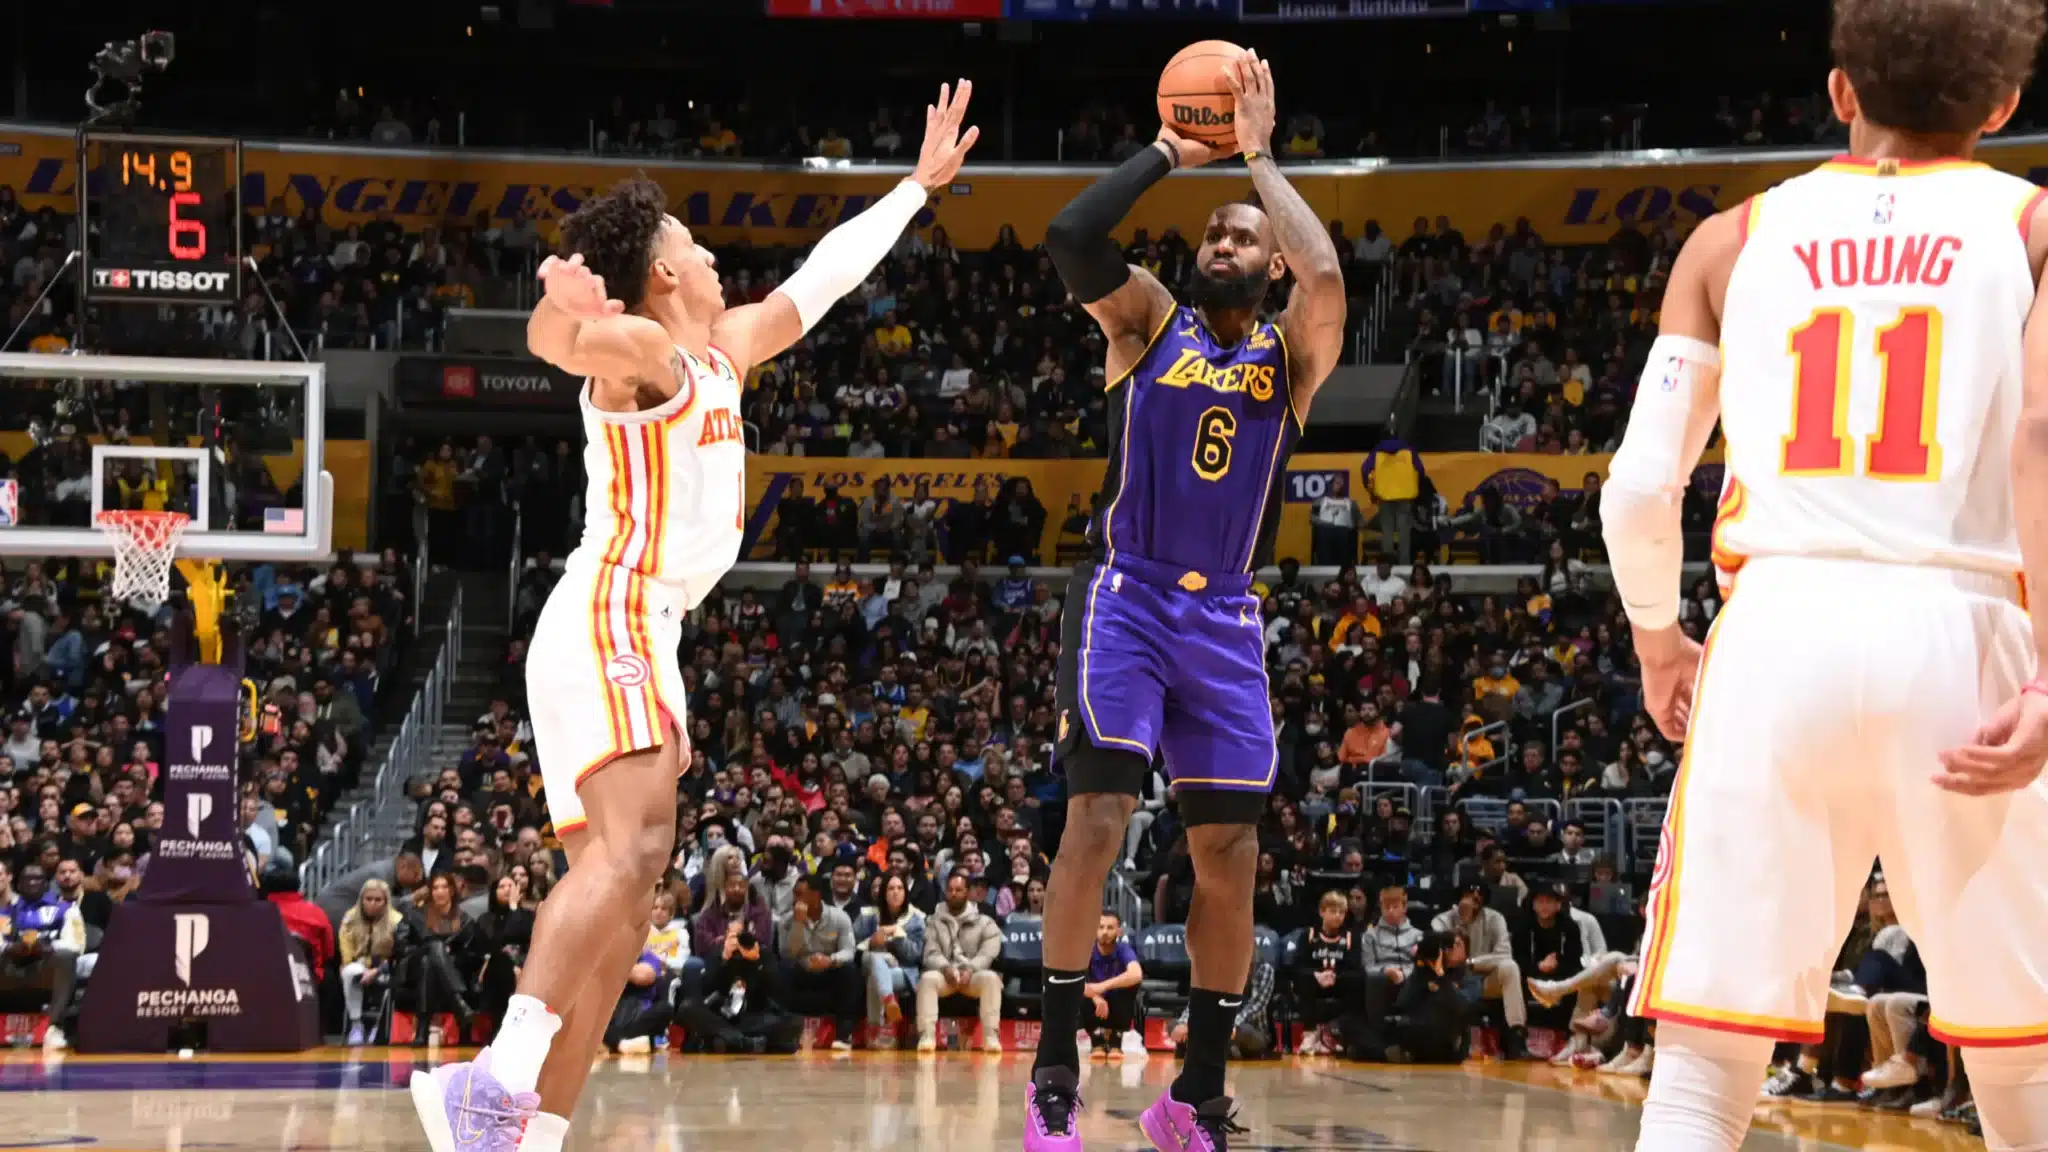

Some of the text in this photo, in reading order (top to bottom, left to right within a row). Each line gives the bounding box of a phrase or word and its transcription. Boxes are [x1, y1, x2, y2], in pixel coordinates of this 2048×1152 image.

[1172, 103, 1236, 125] Wilso
[122, 151, 192, 191] 14.9
[168, 192, 207, 259] 6
[1793, 234, 1963, 290] YOUNG
[132, 271, 230, 291] TISSOT
[481, 374, 551, 392] TOYOTA
[1156, 348, 1275, 401] LAKERS
[1778, 305, 1943, 482] 11
[1191, 405, 1237, 482] 6
[813, 471, 1008, 489] LOS ANGELES
[170, 764, 229, 774] PECHANGA
[160, 840, 233, 852] PECHANGA
[1010, 931, 1043, 943] DELT
[137, 989, 239, 1007] PECHANGA
